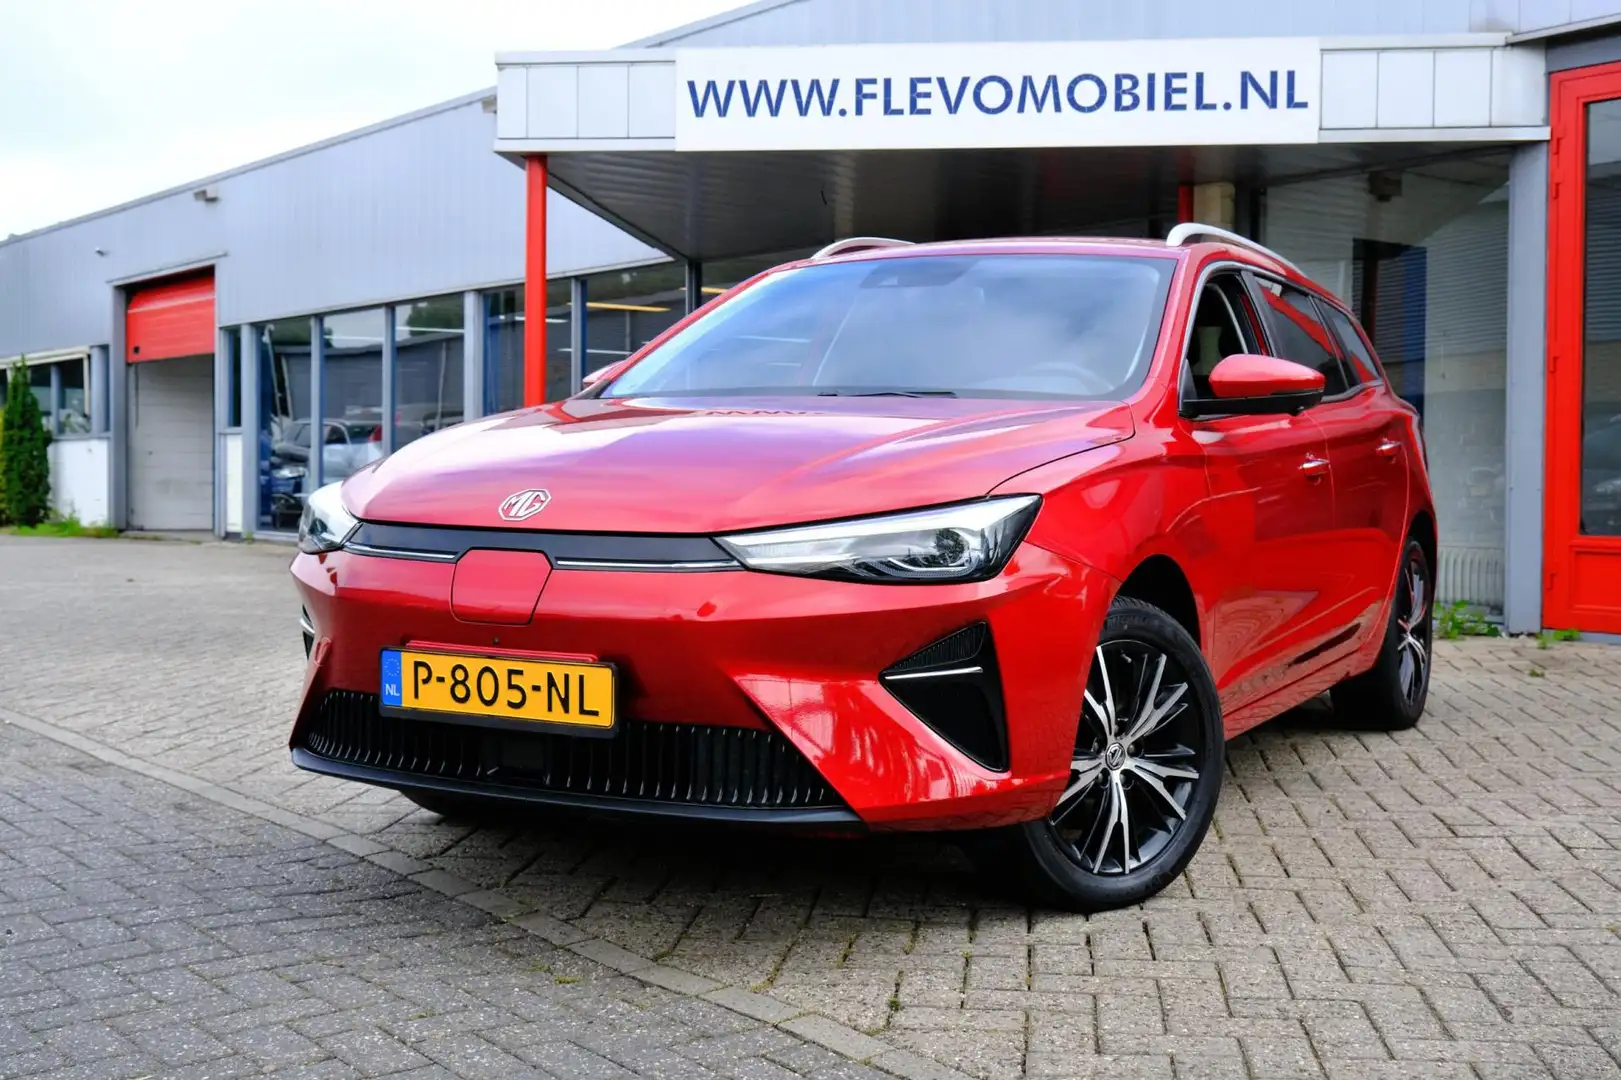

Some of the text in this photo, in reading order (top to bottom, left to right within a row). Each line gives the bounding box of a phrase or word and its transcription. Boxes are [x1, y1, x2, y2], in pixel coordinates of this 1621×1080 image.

[687, 70, 1309, 118] WWW.FLEVOMOBIEL.NL
[502, 490, 548, 518] MG
[385, 683, 400, 697] NL
[413, 660, 599, 717] P-805-NL
